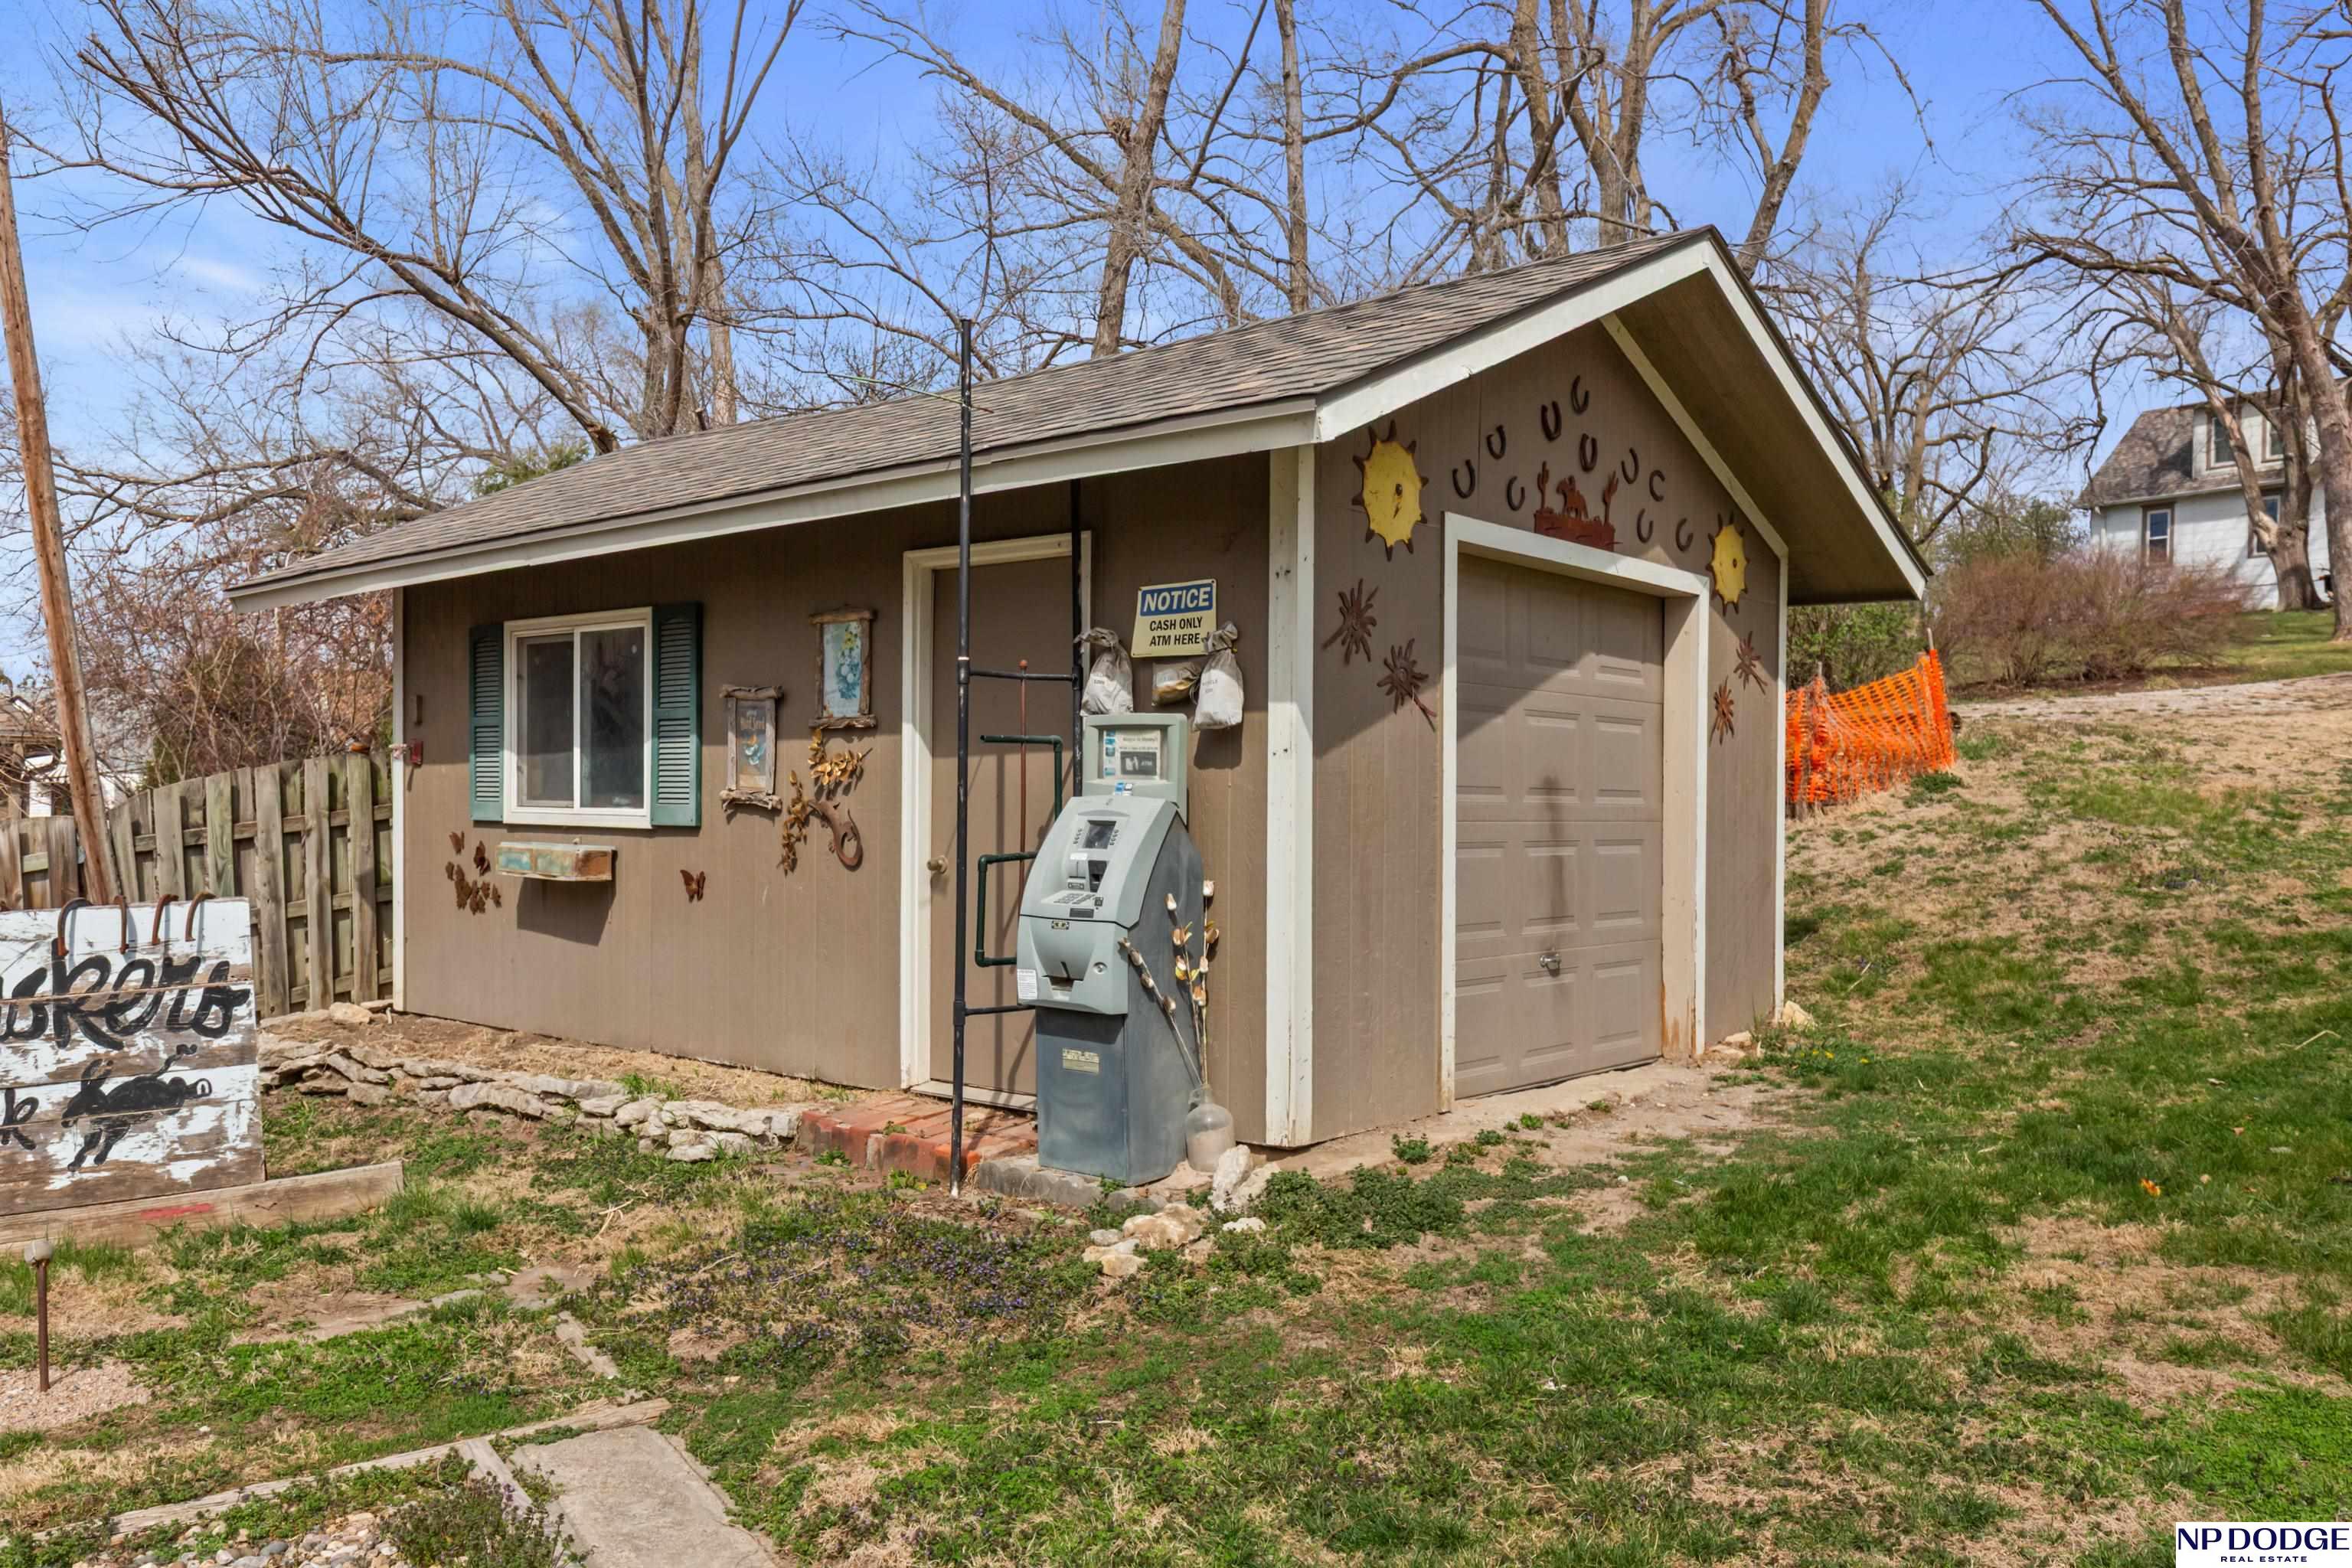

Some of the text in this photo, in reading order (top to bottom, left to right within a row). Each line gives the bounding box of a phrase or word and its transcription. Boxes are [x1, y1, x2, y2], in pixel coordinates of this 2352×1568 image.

[1143, 586, 1211, 612] NOTICE
[1149, 616, 1203, 632] CASH ONLY
[1149, 632, 1200, 647] ATM HERE
